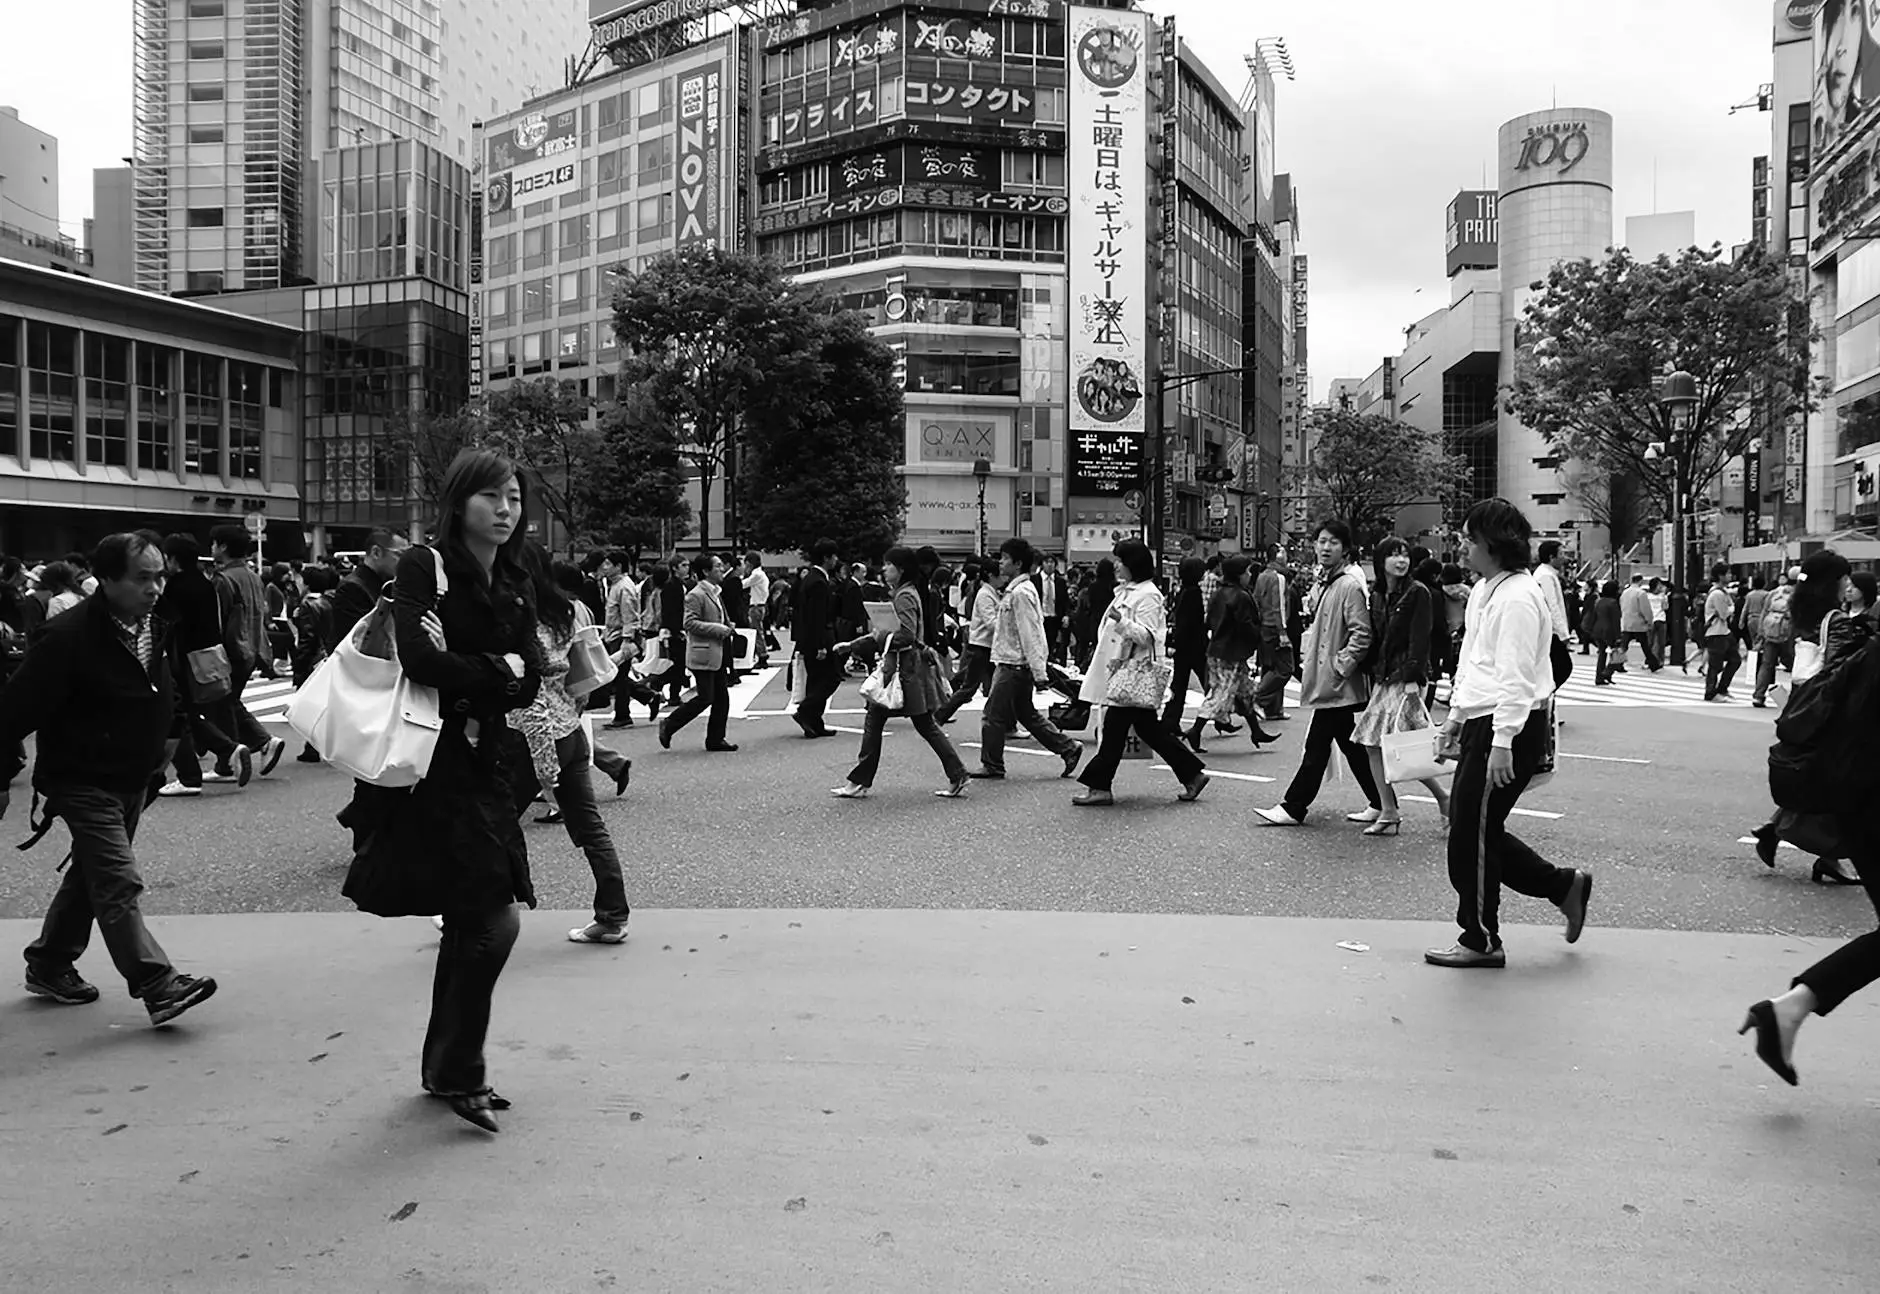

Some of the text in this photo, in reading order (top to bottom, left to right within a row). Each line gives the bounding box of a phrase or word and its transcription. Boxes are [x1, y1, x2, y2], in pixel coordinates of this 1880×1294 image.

[906, 82, 1031, 113] コンタクト
[784, 88, 875, 136] プライス
[1527, 122, 1587, 136] SHIBUYA
[1513, 131, 1590, 174] 109
[679, 118, 704, 240] NOVA
[1476, 195, 1499, 218] TH
[1077, 433, 1139, 455] ギャルサー
[918, 501, 997, 511] www.q-ax.cm
